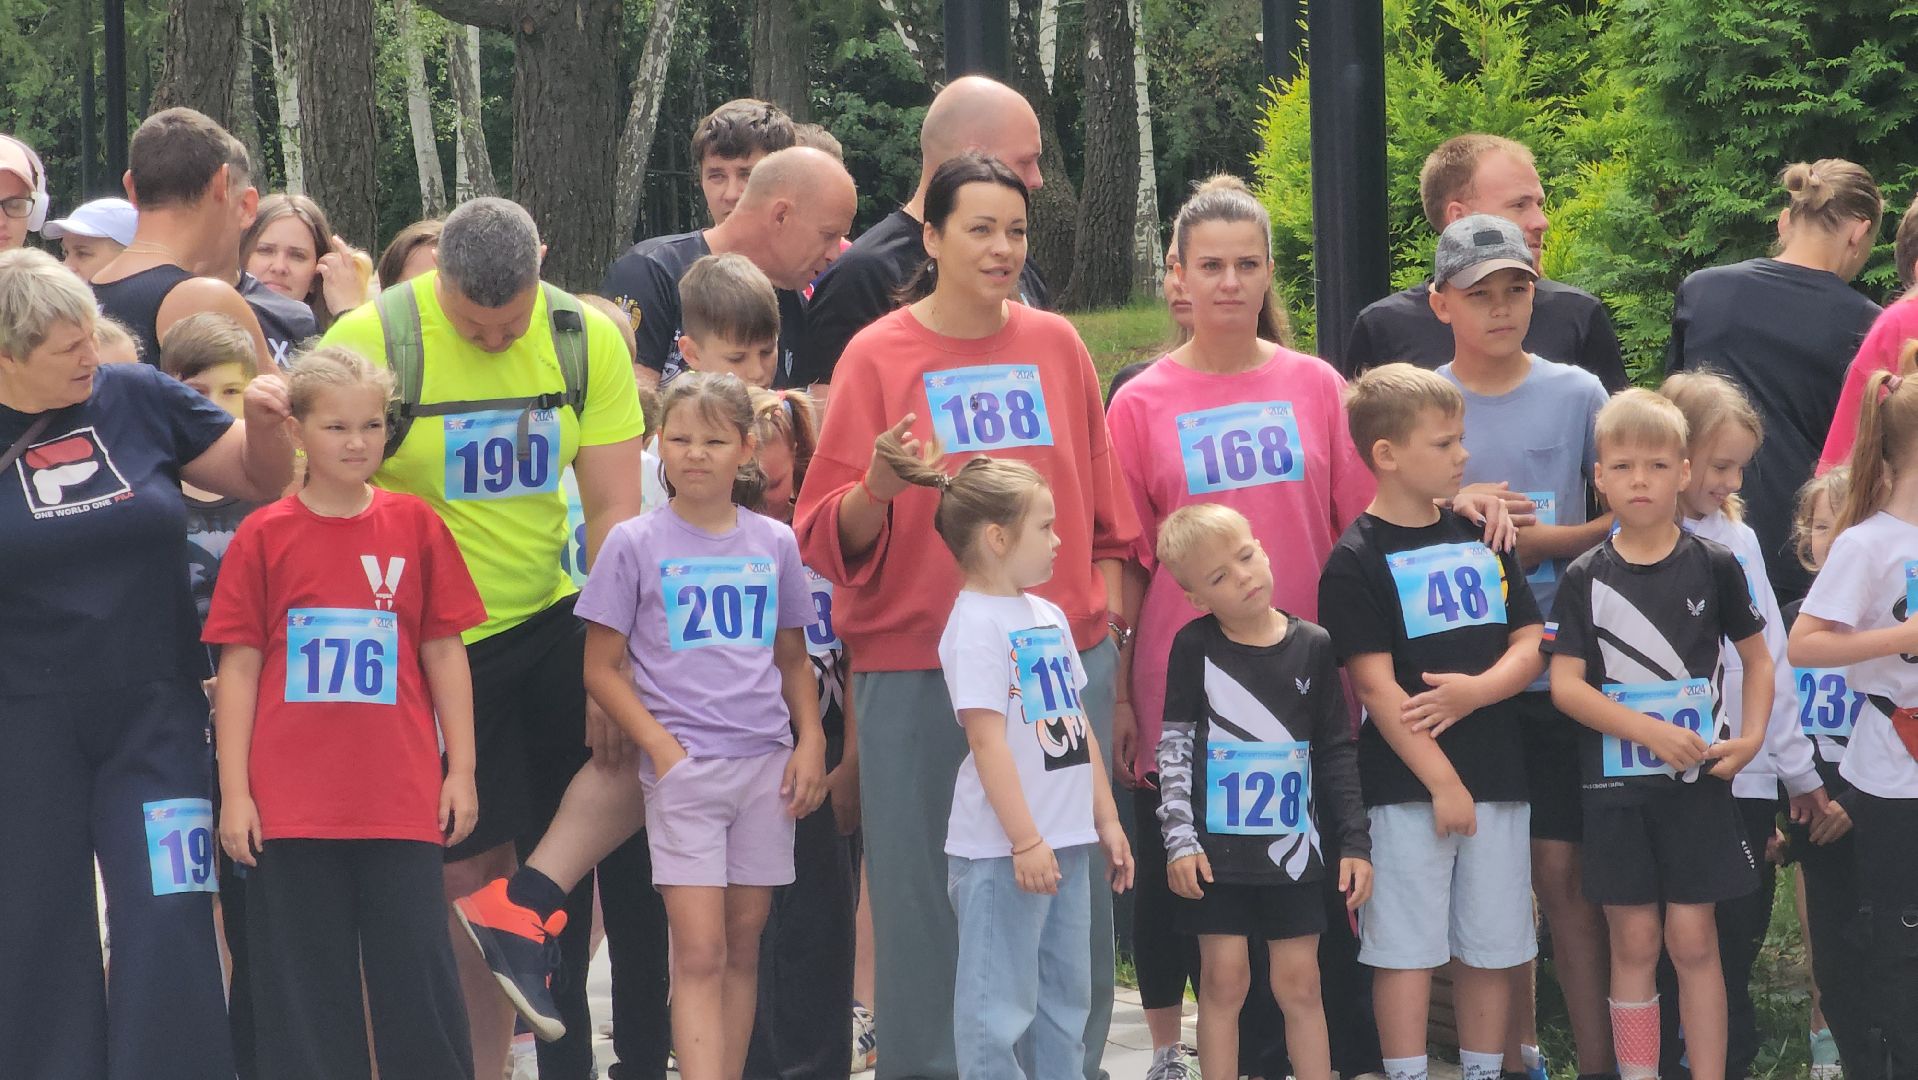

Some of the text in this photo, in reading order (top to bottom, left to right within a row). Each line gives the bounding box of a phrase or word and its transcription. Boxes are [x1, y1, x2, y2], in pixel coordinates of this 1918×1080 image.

[941, 389, 1040, 445] 188
[456, 434, 549, 493] 190
[1192, 425, 1294, 485] 168
[34, 511, 55, 520] ONE
[55, 504, 91, 517] WORLD
[92, 499, 112, 510] ONE
[677, 584, 768, 642] 207
[1427, 565, 1488, 622] 48
[300, 638, 384, 696] 176
[1218, 771, 1302, 828] 128
